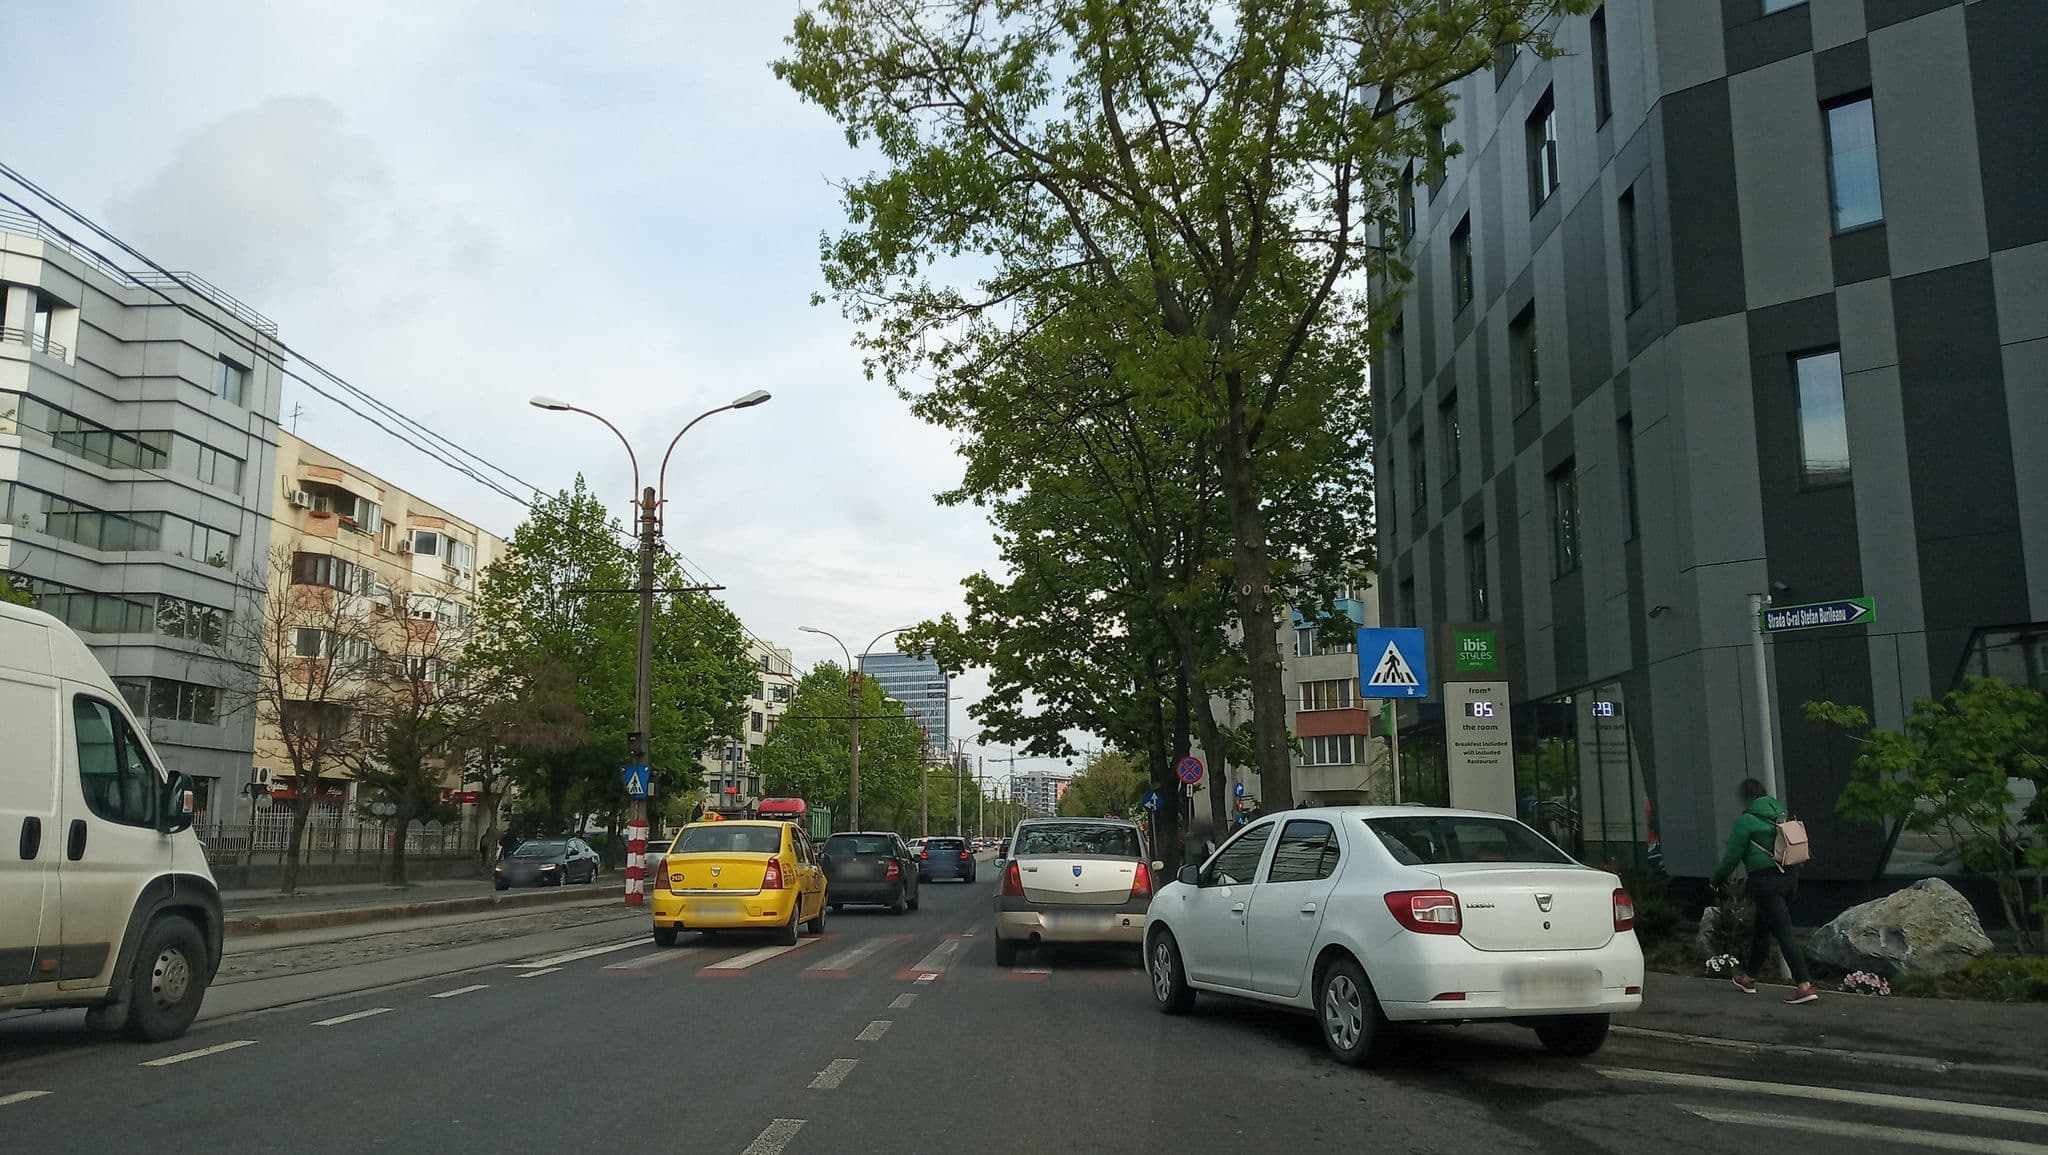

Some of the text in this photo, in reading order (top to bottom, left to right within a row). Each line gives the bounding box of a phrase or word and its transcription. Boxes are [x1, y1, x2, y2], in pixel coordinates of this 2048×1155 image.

[1767, 613, 1786, 628] Strada
[1463, 639, 1487, 651] ibis
[1474, 702, 1493, 717] 85
[1462, 723, 1476, 731] the
